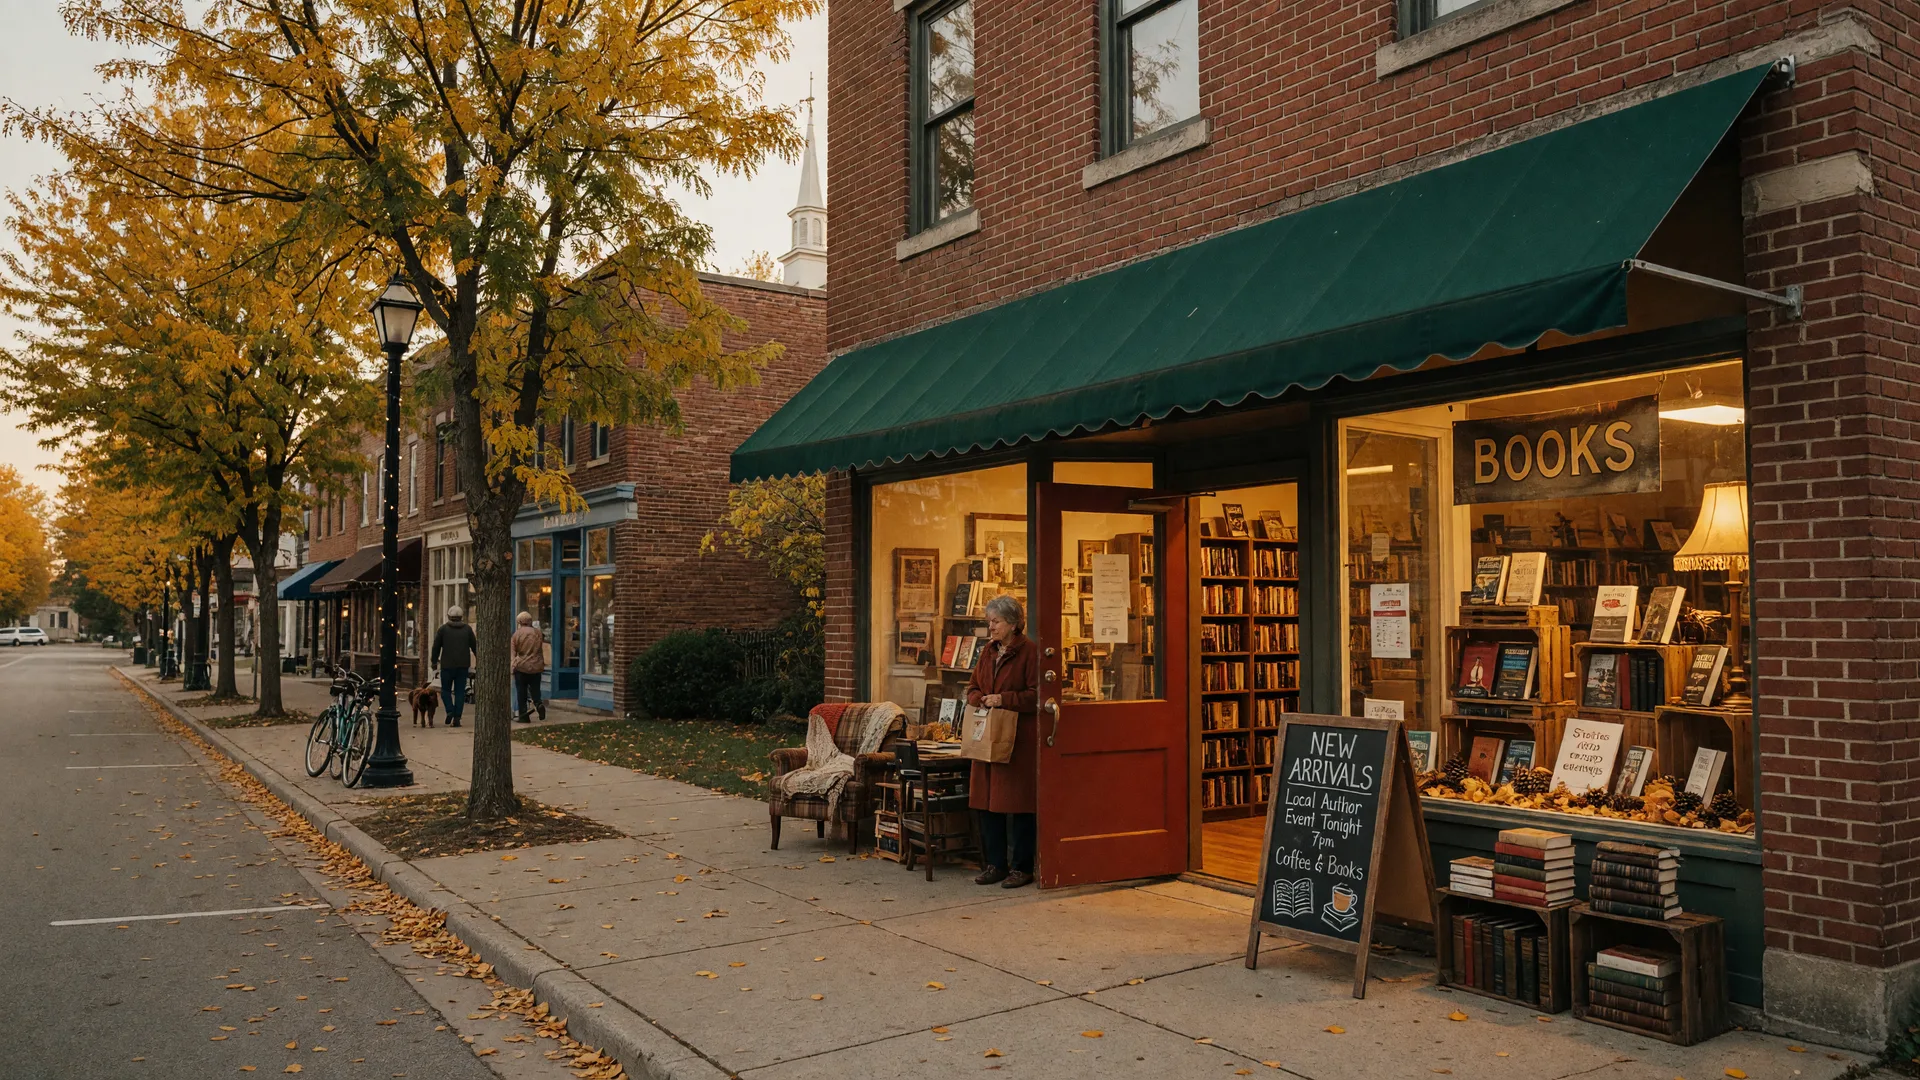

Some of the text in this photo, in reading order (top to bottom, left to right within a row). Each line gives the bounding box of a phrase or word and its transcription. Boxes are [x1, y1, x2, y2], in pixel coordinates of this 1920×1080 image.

[1474, 420, 1636, 485] BOOKS
[1310, 731, 1358, 759] NEW
[1287, 757, 1373, 790] ARRIVALS
[1285, 788, 1363, 815] Local Author
[1285, 808, 1363, 840] Event Tonight
[1311, 830, 1335, 850] 7pm
[1275, 846, 1364, 881] Coffee & Books
